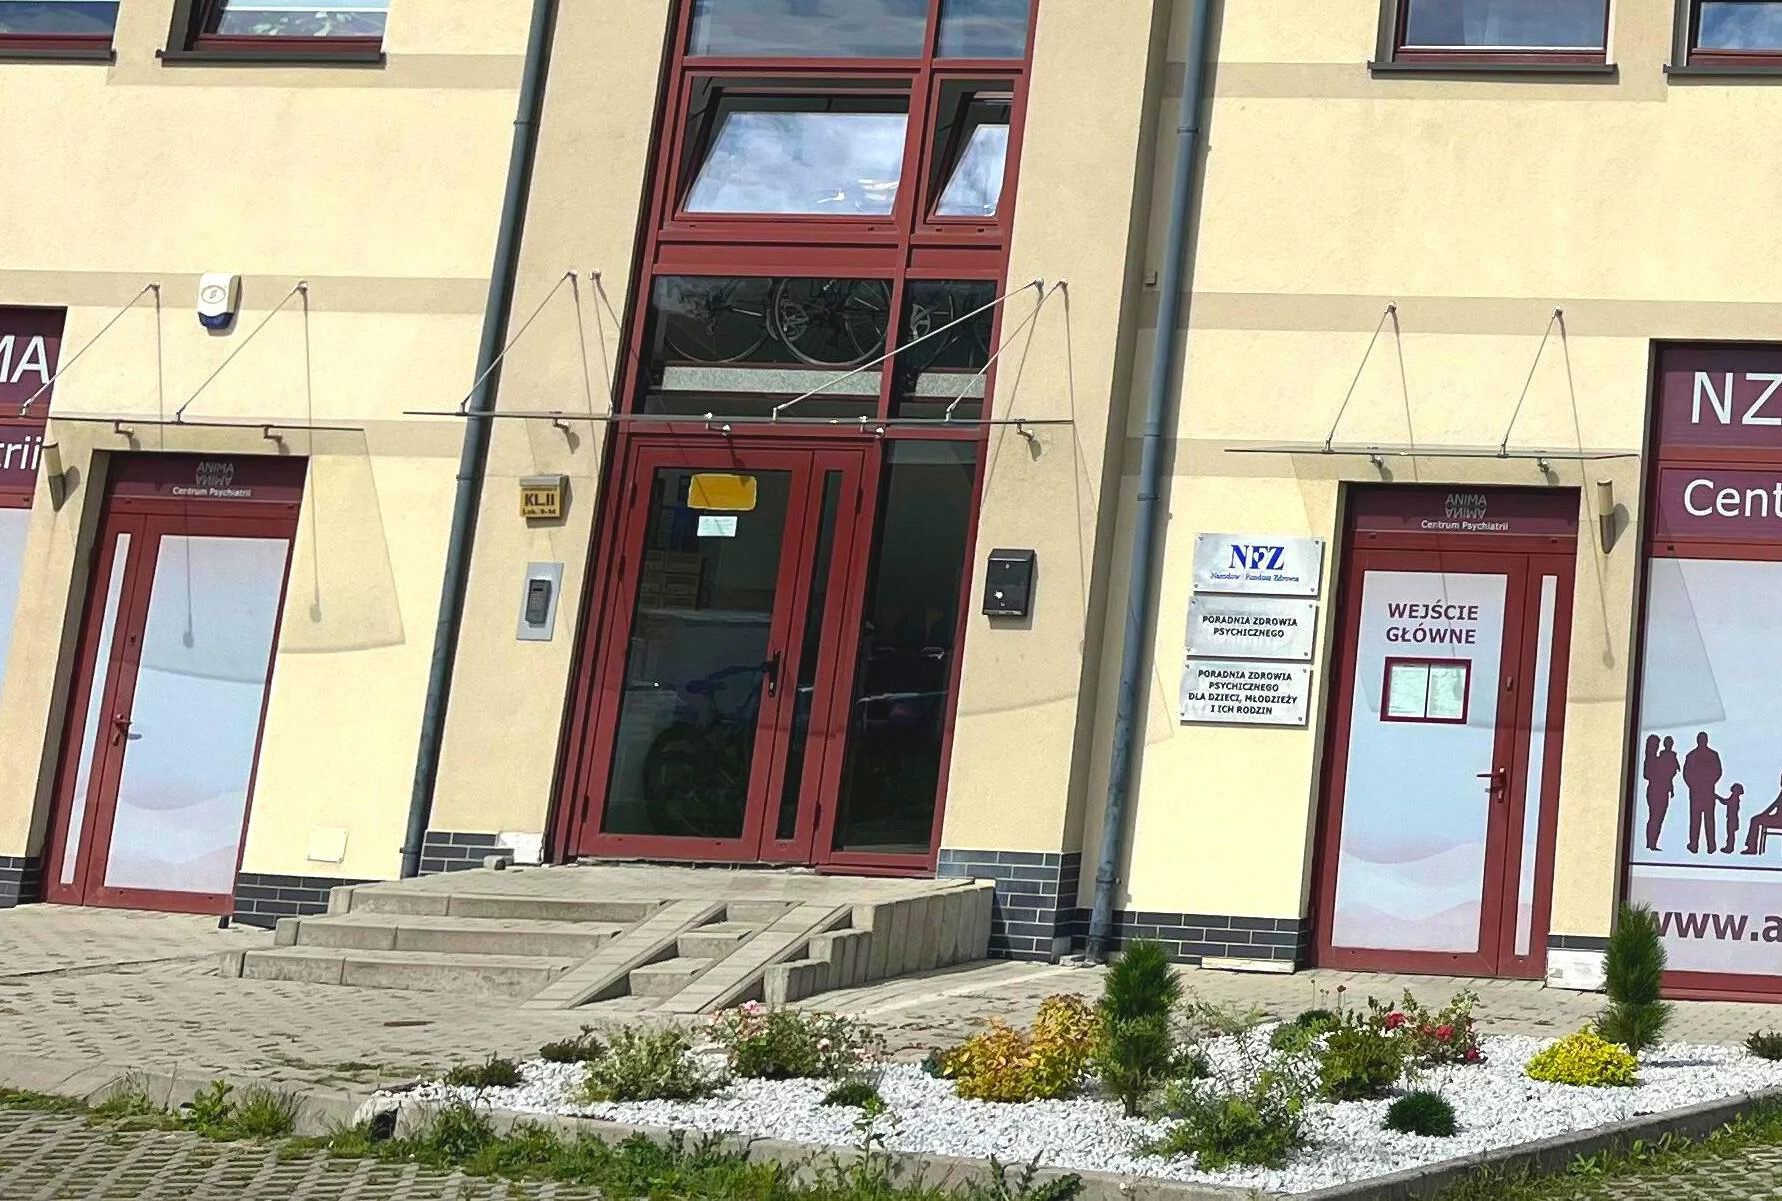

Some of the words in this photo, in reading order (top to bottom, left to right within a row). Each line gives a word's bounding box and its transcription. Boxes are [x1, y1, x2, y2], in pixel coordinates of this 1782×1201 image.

[172, 486, 208, 496] Centrum
[1445, 493, 1487, 506] ANIMA
[1421, 519, 1460, 529] Centrum
[1462, 521, 1508, 531] Psychiatrii
[1228, 544, 1285, 571] NFZ
[1387, 599, 1479, 621] WEJŚCIE
[1202, 615, 1251, 625] PORADNIA
[1252, 617, 1298, 627] ZDROWIA
[1213, 627, 1285, 638] PSYCHICZNEGO
[1386, 622, 1477, 645] GŁÓWNE
[1198, 669, 1246, 679] PORADNIA
[1248, 671, 1292, 681] ZDROWIA
[1208, 681, 1279, 692] PSYCHICZNEGO
[1188, 692, 1206, 701] DLA
[1208, 693, 1242, 703] DZIECI,
[1244, 694, 1298, 704] MŁODZIEŻY
[1210, 704, 1215, 713] I
[1217, 705, 1234, 714] ICH
[1236, 705, 1273, 715] RODZIN
